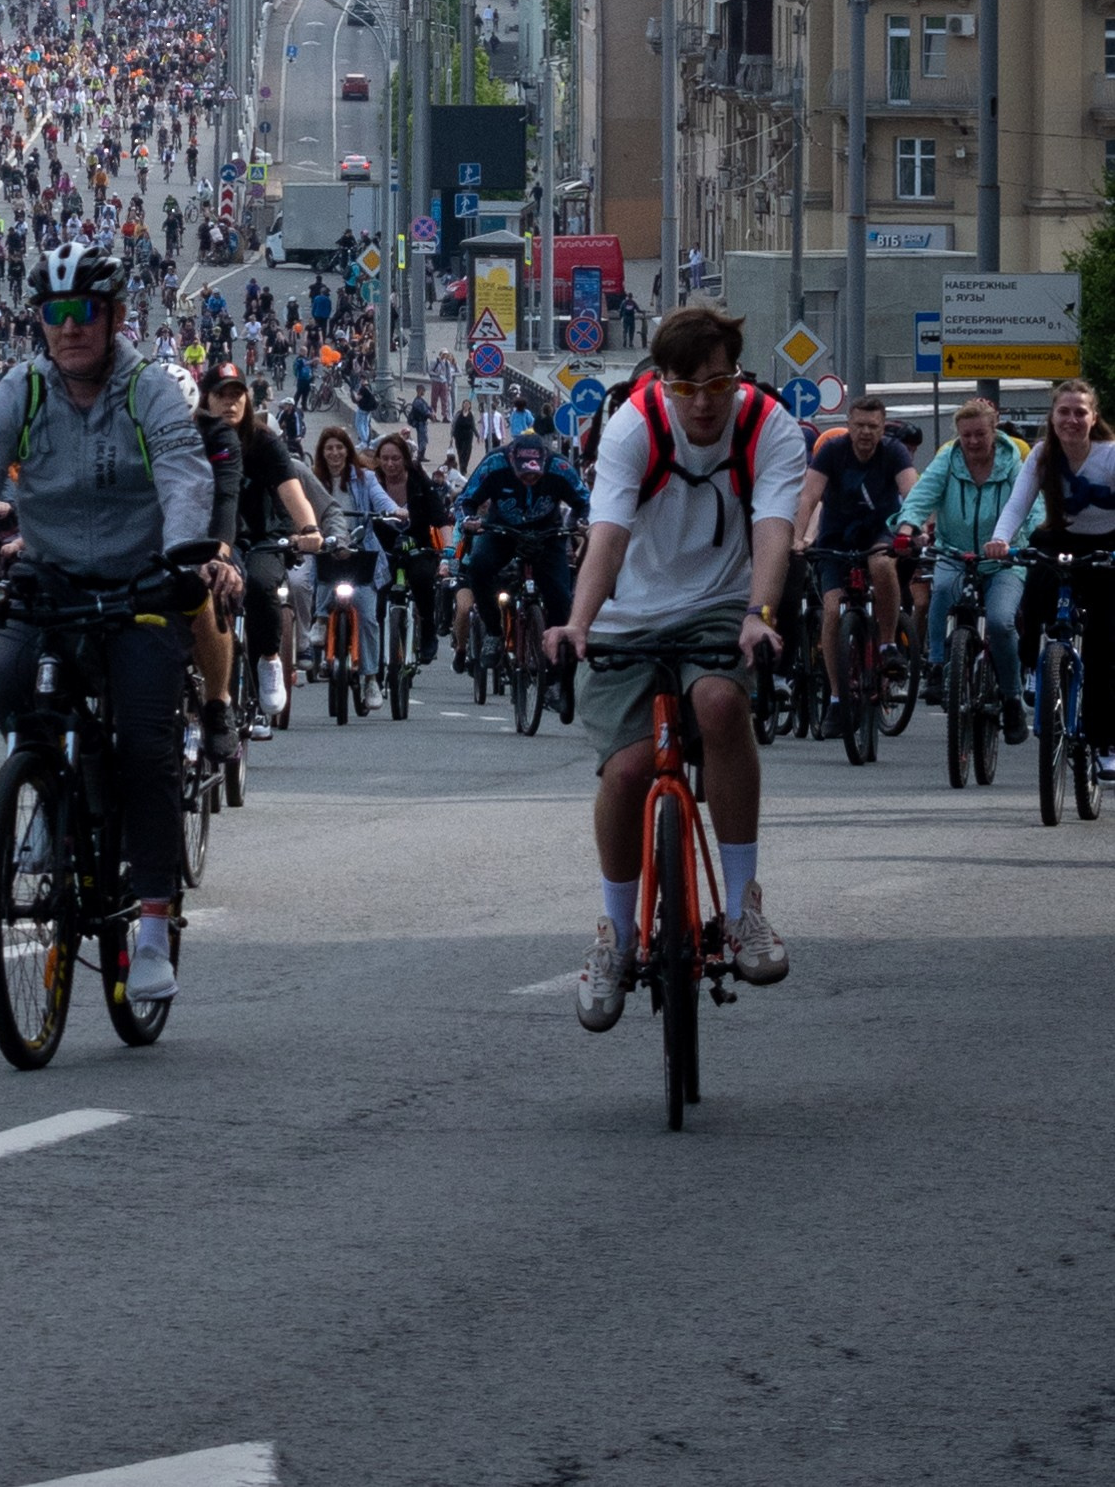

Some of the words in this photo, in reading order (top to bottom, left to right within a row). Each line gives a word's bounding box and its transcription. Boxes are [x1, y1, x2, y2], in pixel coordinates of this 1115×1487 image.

[877, 234, 899, 247] ВТБ
[945, 281, 1018, 290] НАБЕРЕЖНЫЕ
[945, 294, 953, 302] р.
[956, 293, 985, 302] ЯУЗЫ
[945, 315, 1046, 325] СЕРЕБРЯНИЧЕСКАЯ
[1048, 321, 1061, 330] 0.1
[945, 327, 1003, 335] набережная
[958, 352, 1002, 361] КЛИНИКА
[958, 363, 1021, 371] стоматология
